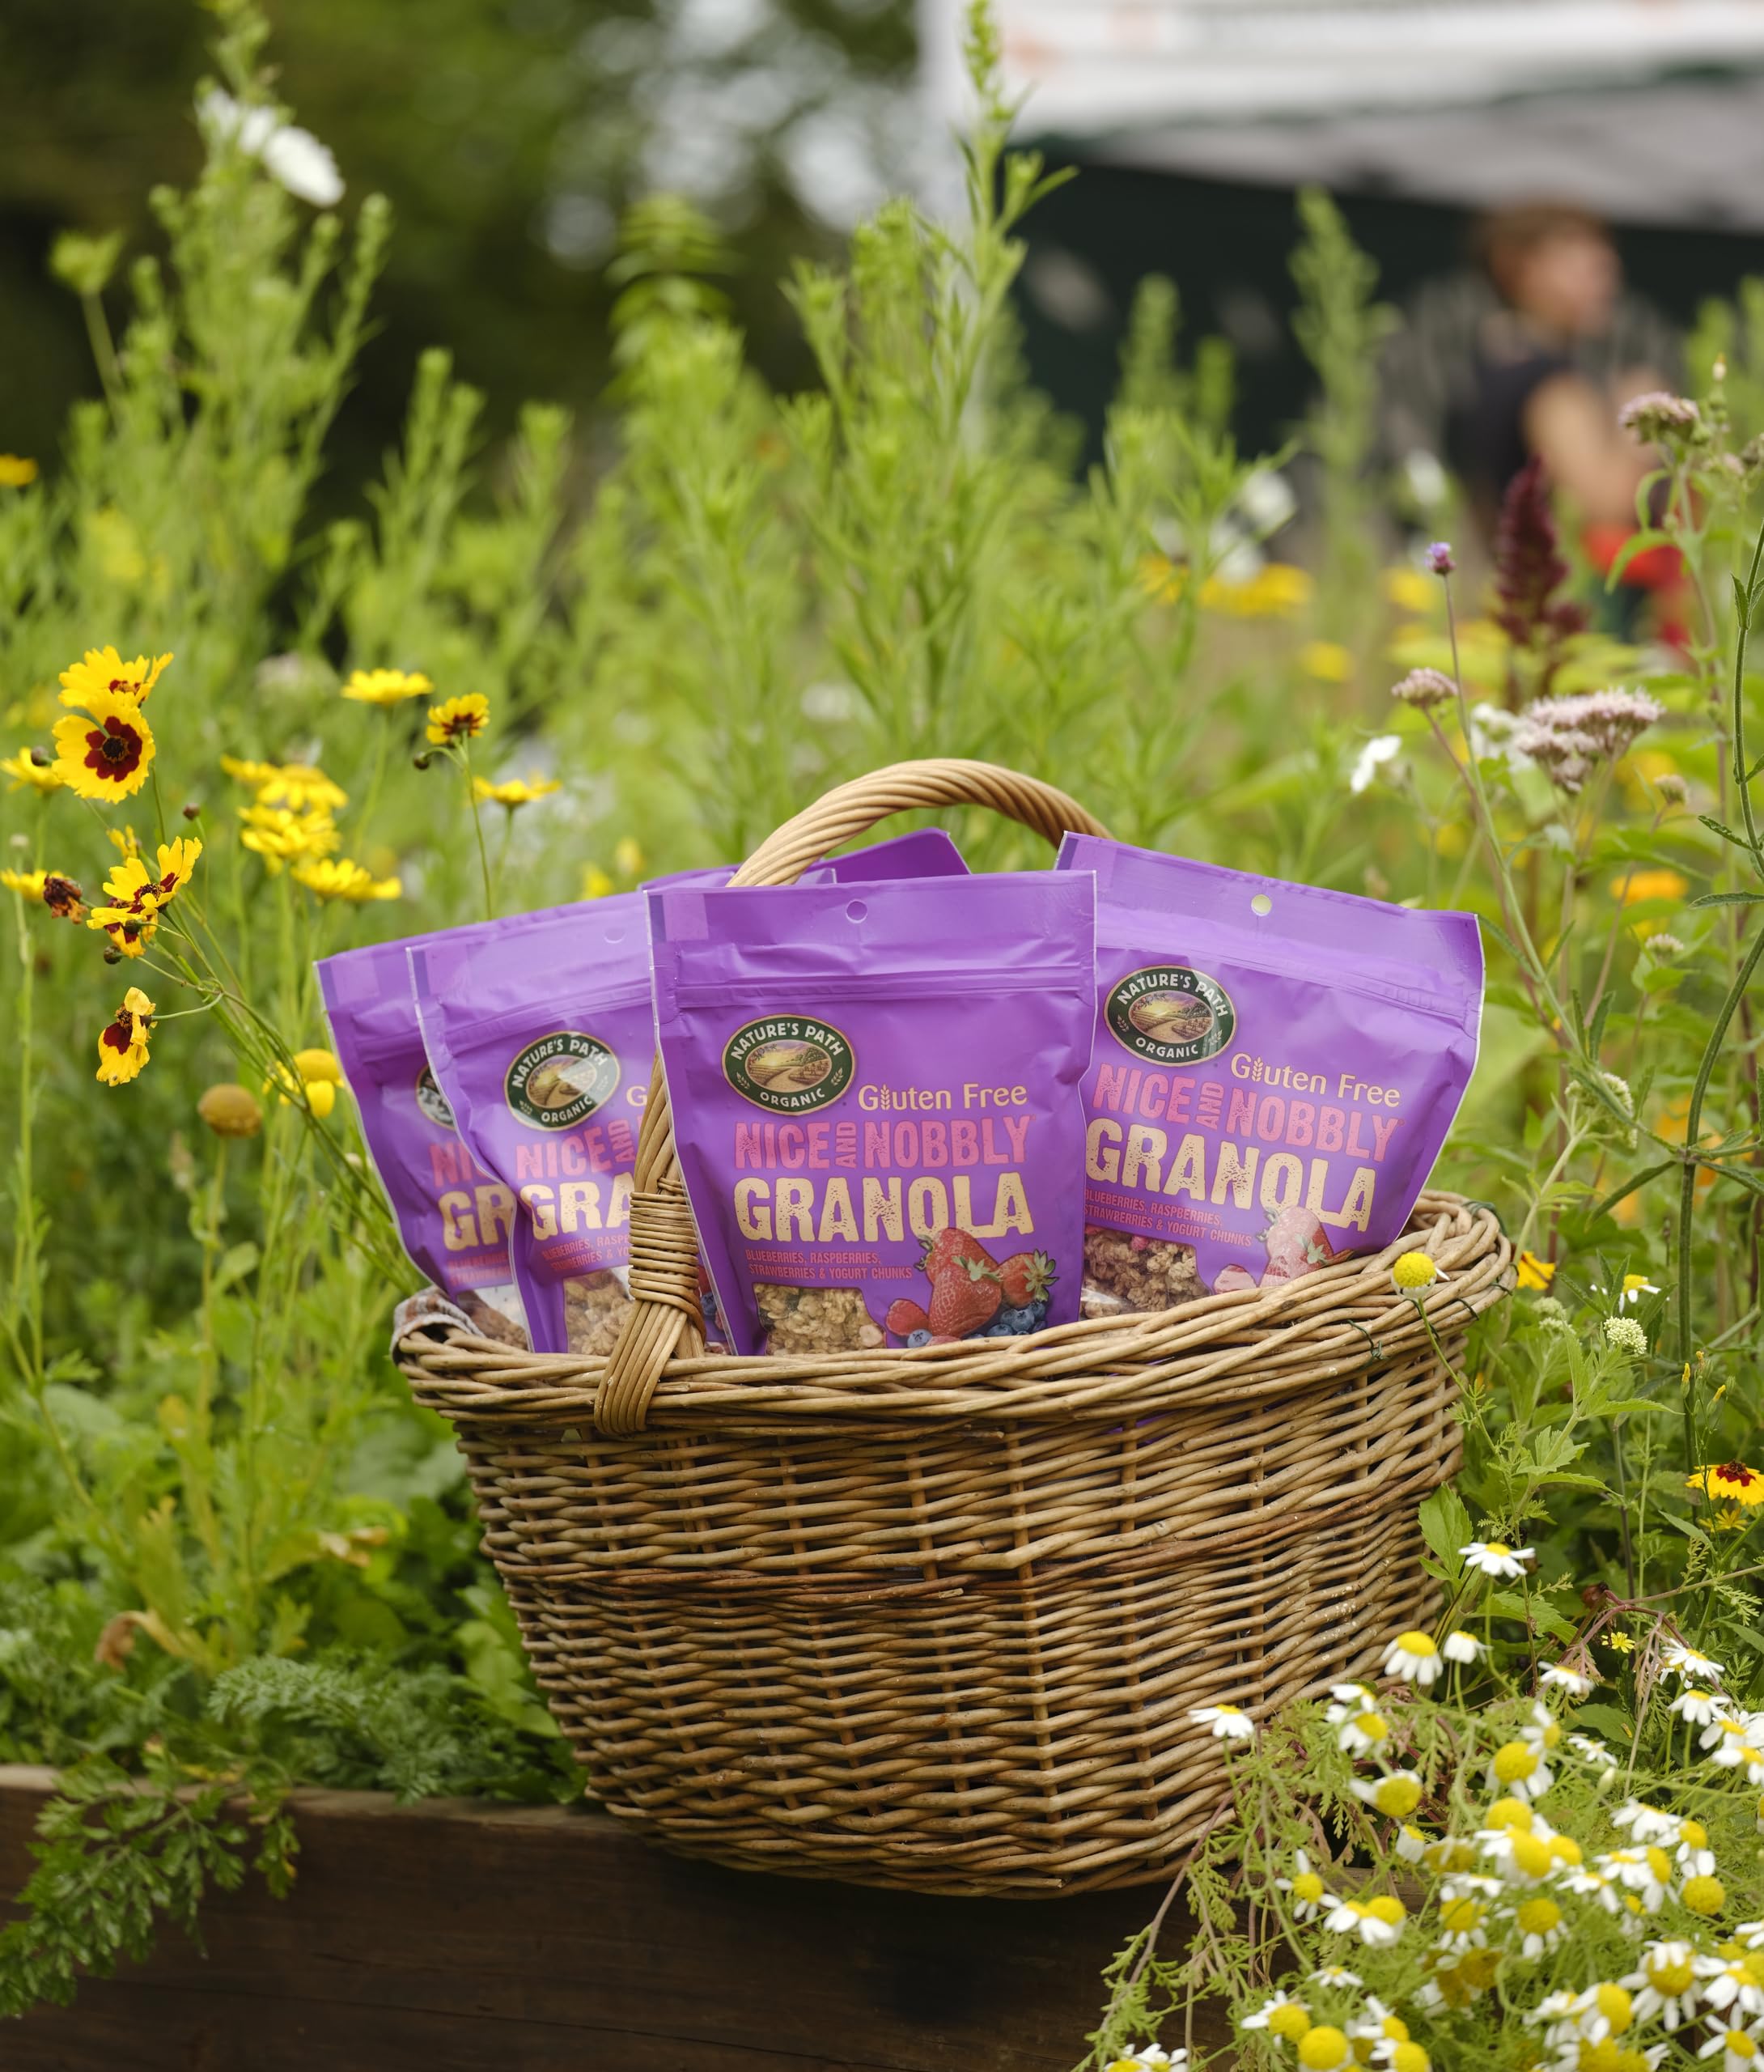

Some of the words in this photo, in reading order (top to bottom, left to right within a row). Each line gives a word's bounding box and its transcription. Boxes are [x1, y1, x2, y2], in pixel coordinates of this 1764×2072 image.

[1117, 974, 1191, 1004] NATURE'S
[1195, 982, 1228, 1017] PATH
[730, 1022, 799, 1060] NATURE'S
[805, 1025, 844, 1056] PATH
[1135, 1038, 1198, 1058] ORGANIC
[511, 1038, 563, 1088] NATURE'S
[569, 1039, 608, 1066] PATH
[1231, 1053, 1327, 1094] Gluten
[1338, 1074, 1400, 1107] Free
[541, 1096, 593, 1123] ORGANIC
[760, 1088, 825, 1107] ORGANIC
[858, 1084, 952, 1111] Gluten
[964, 1083, 1028, 1109] Free
[1092, 1063, 1197, 1123] NICE
[1195, 1082, 1224, 1130] AND
[1227, 1087, 1398, 1162] NOBBLY
[515, 1126, 613, 1179] NICE
[608, 1119, 636, 1163] AND
[735, 1121, 830, 1169] NICE
[835, 1121, 857, 1169] AND
[864, 1115, 1031, 1169] NOBBLY
[1086, 1118, 1376, 1232] GRANOLA
[733, 1172, 1034, 1242] GRANOLA
[1151, 1203, 1223, 1226] RASPBERRIES,
[1156, 1219, 1163, 1230] &
[1168, 1221, 1207, 1238] YOGURT
[1211, 1229, 1252, 1246] CHUNKS
[607, 1249, 613, 1260] &
[745, 1249, 808, 1266] BLUEBERRIES,
[810, 1252, 881, 1264] RASPBERRIES,
[748, 1263, 816, 1280] STRAWBERRIES
[819, 1267, 825, 1279] &
[829, 1267, 867, 1280] YOGURT
[871, 1267, 912, 1279] CHUNKS
